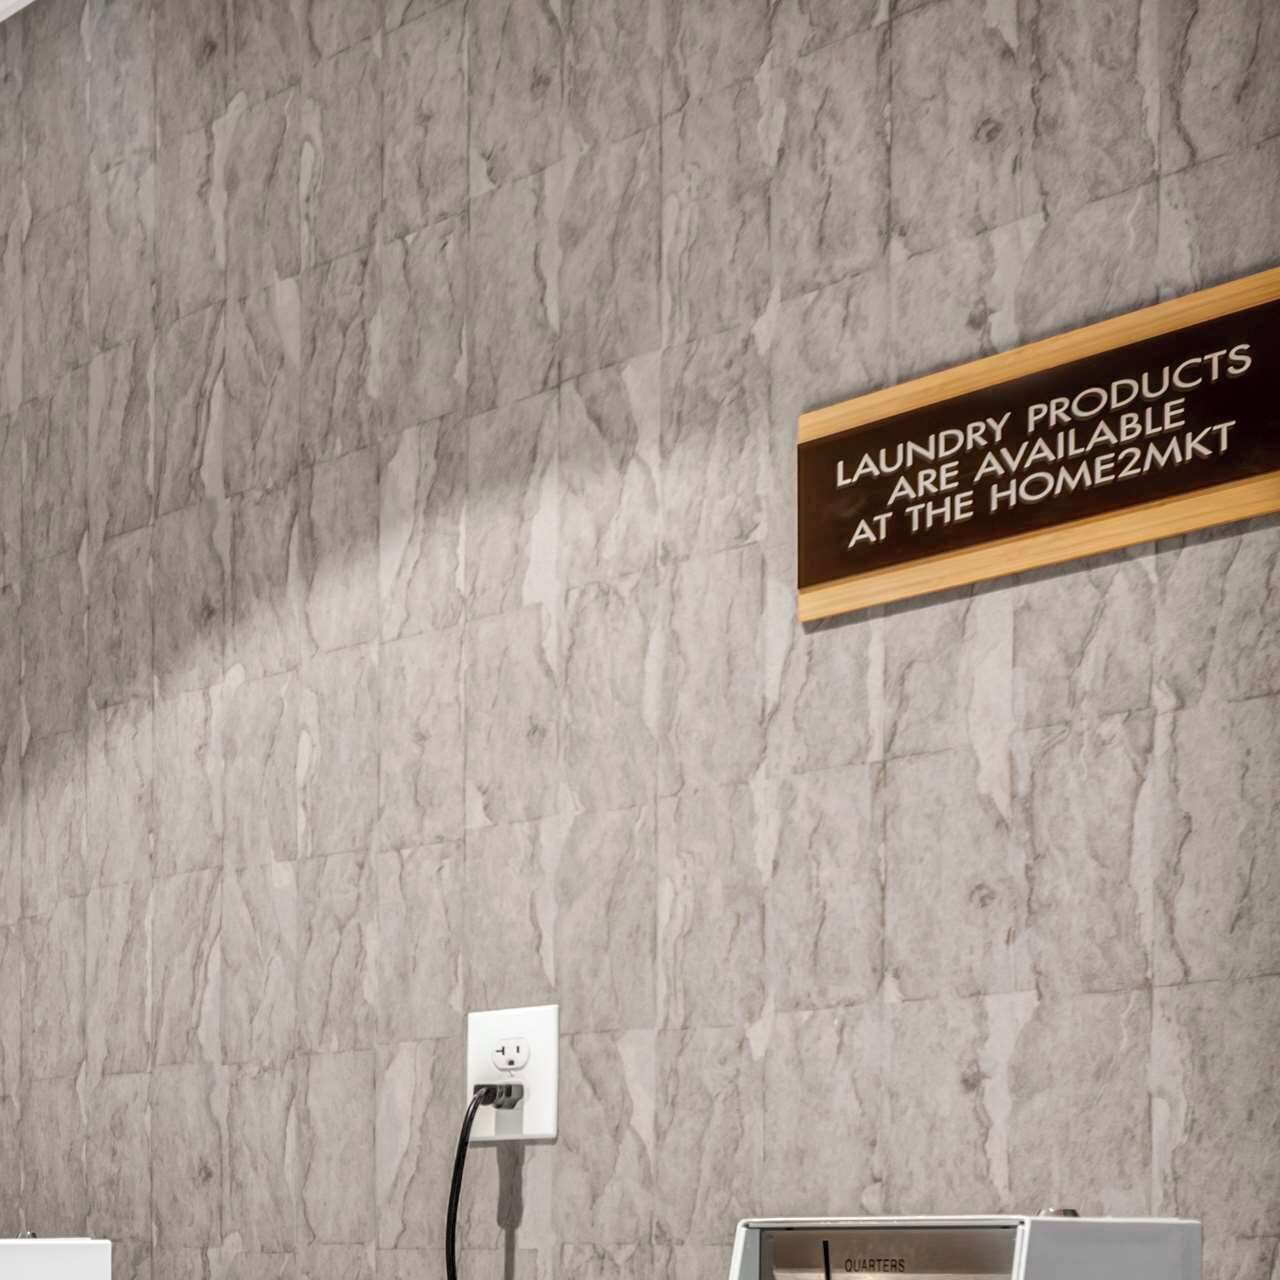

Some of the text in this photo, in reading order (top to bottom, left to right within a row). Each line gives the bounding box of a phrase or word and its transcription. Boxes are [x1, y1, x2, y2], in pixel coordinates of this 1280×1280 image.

[836, 343, 1254, 488] LAUNDRY PRODUCTS
[887, 398, 1187, 507] ARE AVAILABLE
[847, 420, 1237, 549] AT THE HOME2MKT
[844, 1258, 905, 1273] QUARTERS
